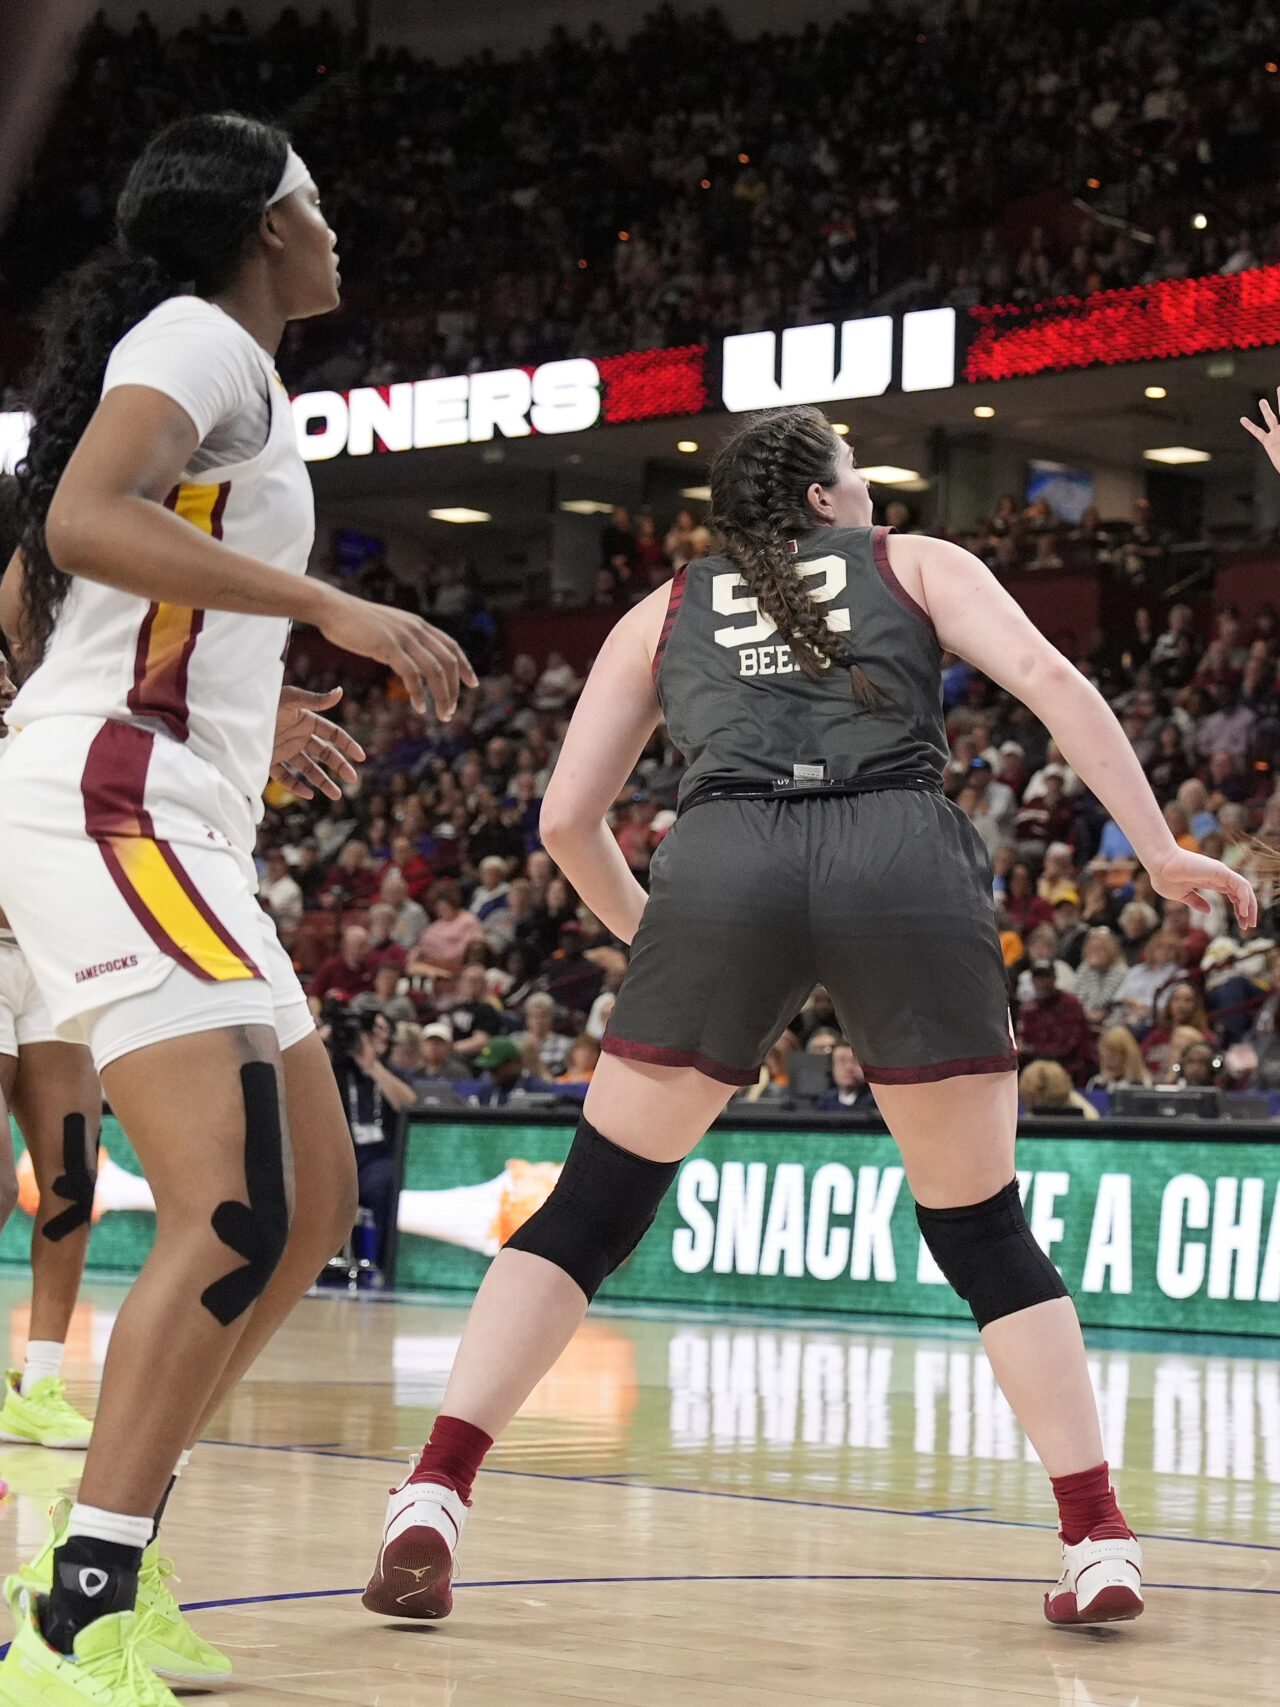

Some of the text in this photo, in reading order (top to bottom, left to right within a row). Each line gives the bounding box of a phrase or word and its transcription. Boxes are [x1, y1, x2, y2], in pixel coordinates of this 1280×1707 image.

[291, 358, 601, 462] ONERS
[712, 554, 852, 648] 52
[75, 954, 138, 983] GAMECOCKS
[672, 1158, 905, 1283] SNACK
[1082, 1173, 1133, 1294] A
